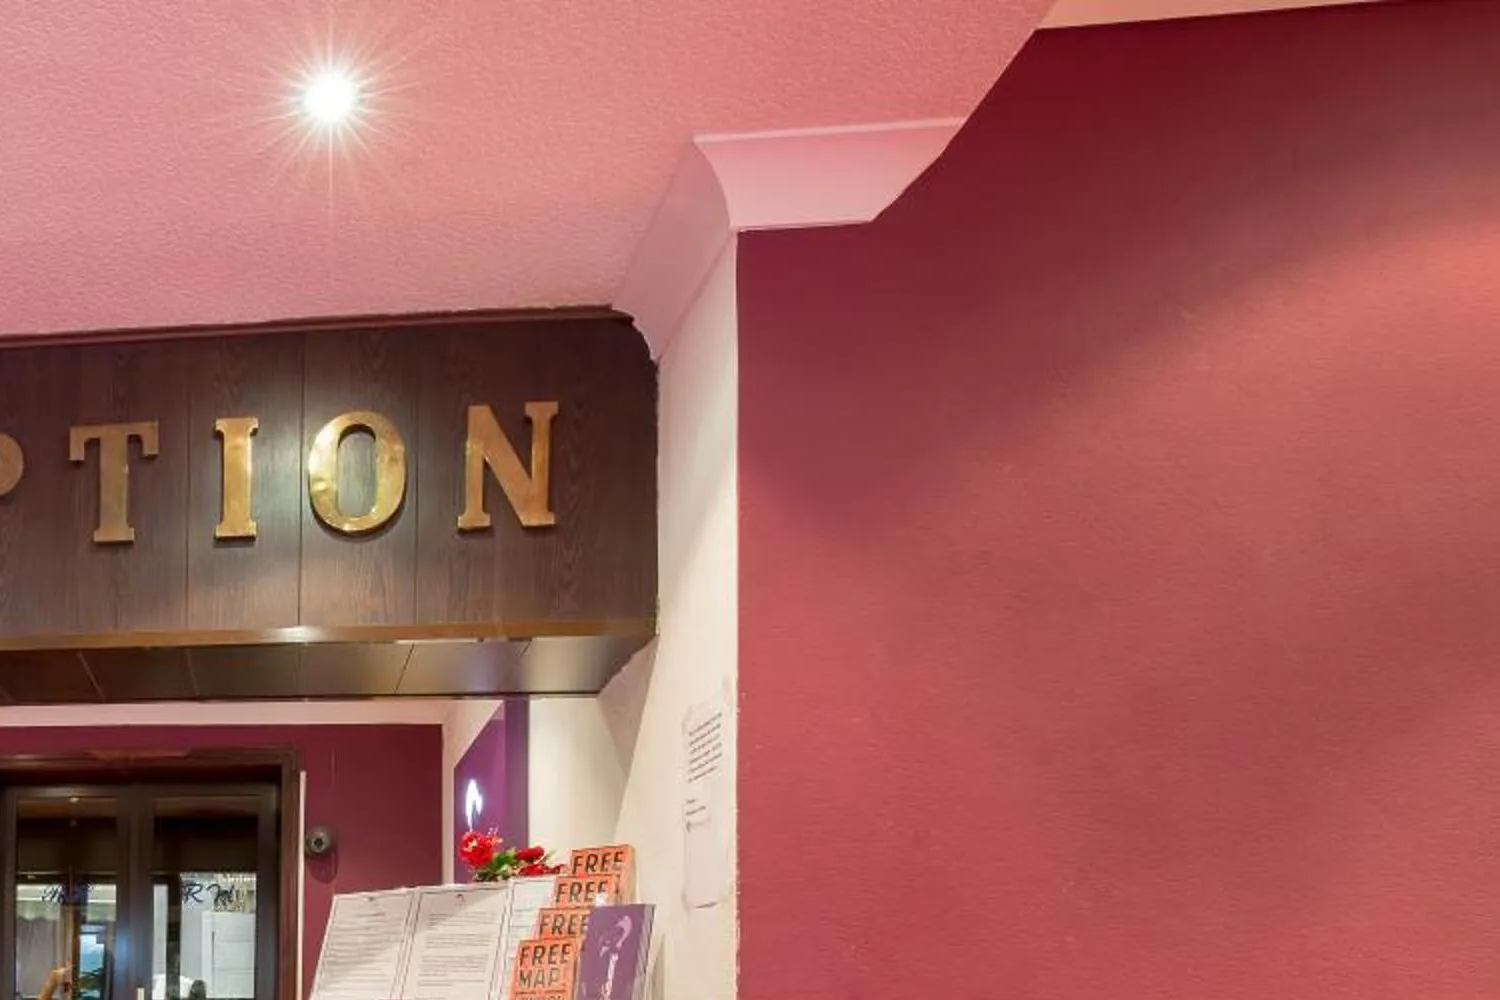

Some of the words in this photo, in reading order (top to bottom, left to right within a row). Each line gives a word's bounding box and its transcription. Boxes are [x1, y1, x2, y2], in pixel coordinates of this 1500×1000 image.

[572, 851, 625, 875] FREE
[555, 880, 609, 903] FREE
[520, 943, 571, 967] FREE
